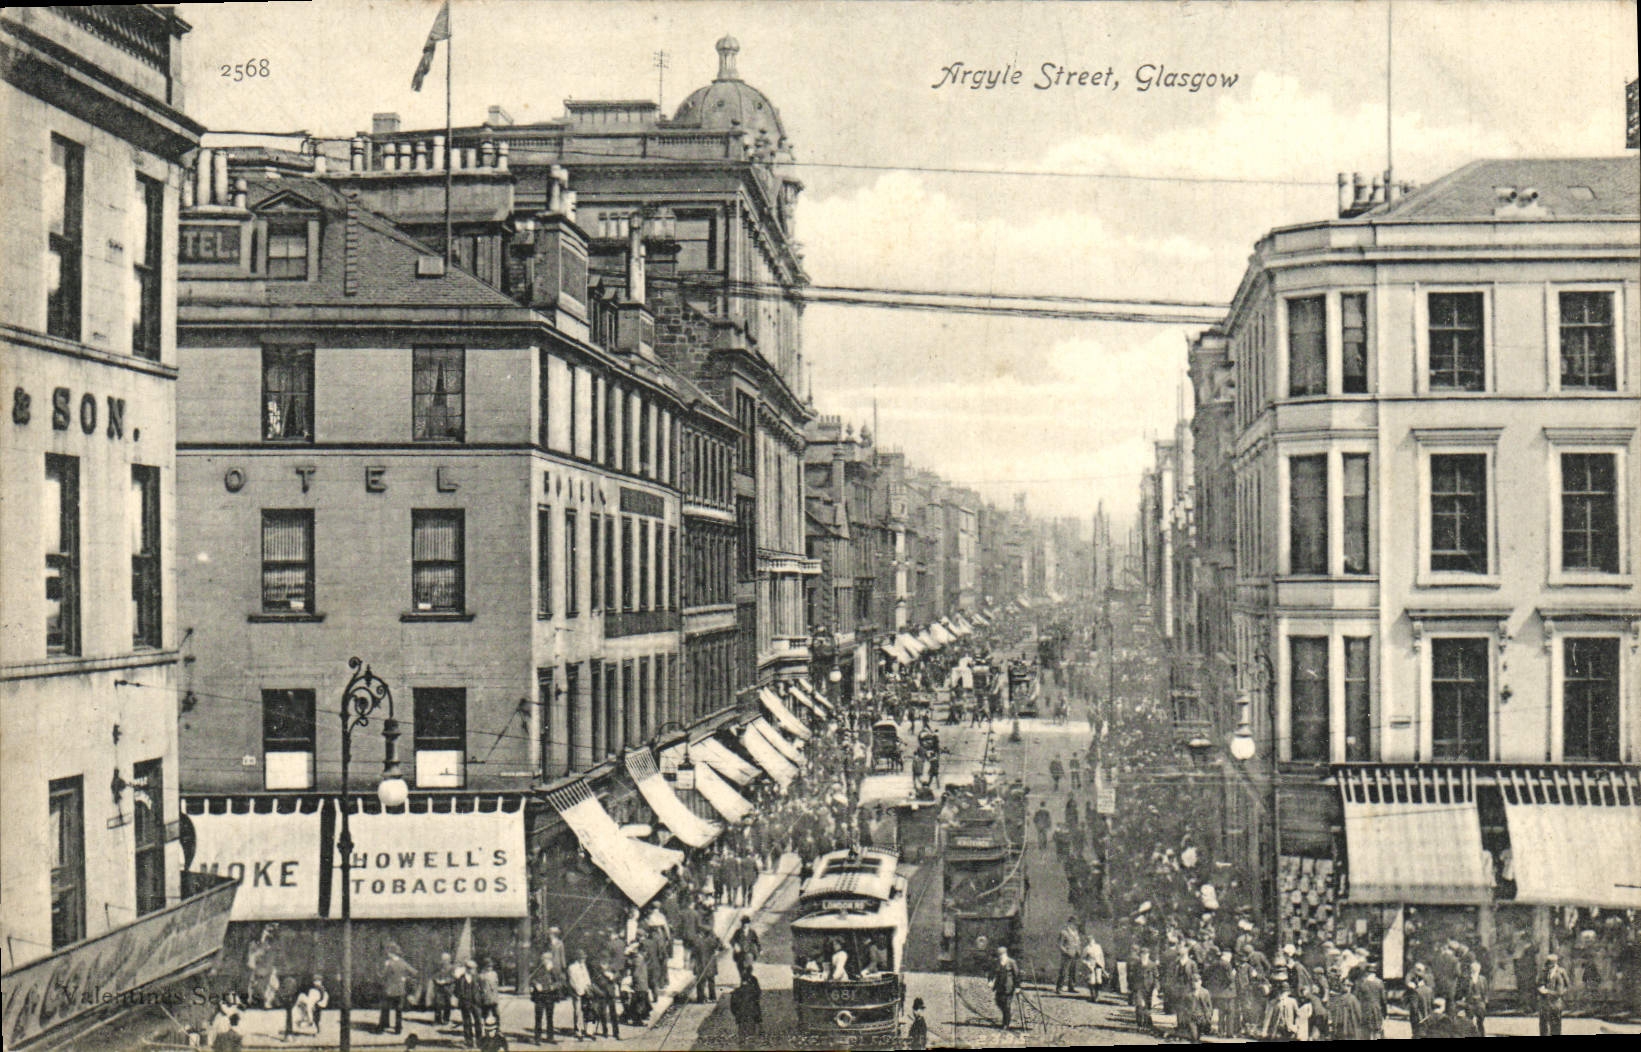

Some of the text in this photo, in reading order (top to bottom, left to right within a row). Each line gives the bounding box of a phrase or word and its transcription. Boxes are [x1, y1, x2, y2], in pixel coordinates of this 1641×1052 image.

[12, 386, 141, 442] & SON.
[352, 847, 508, 869] HOWELL'S
[350, 877, 517, 895] TOBACCOS.
